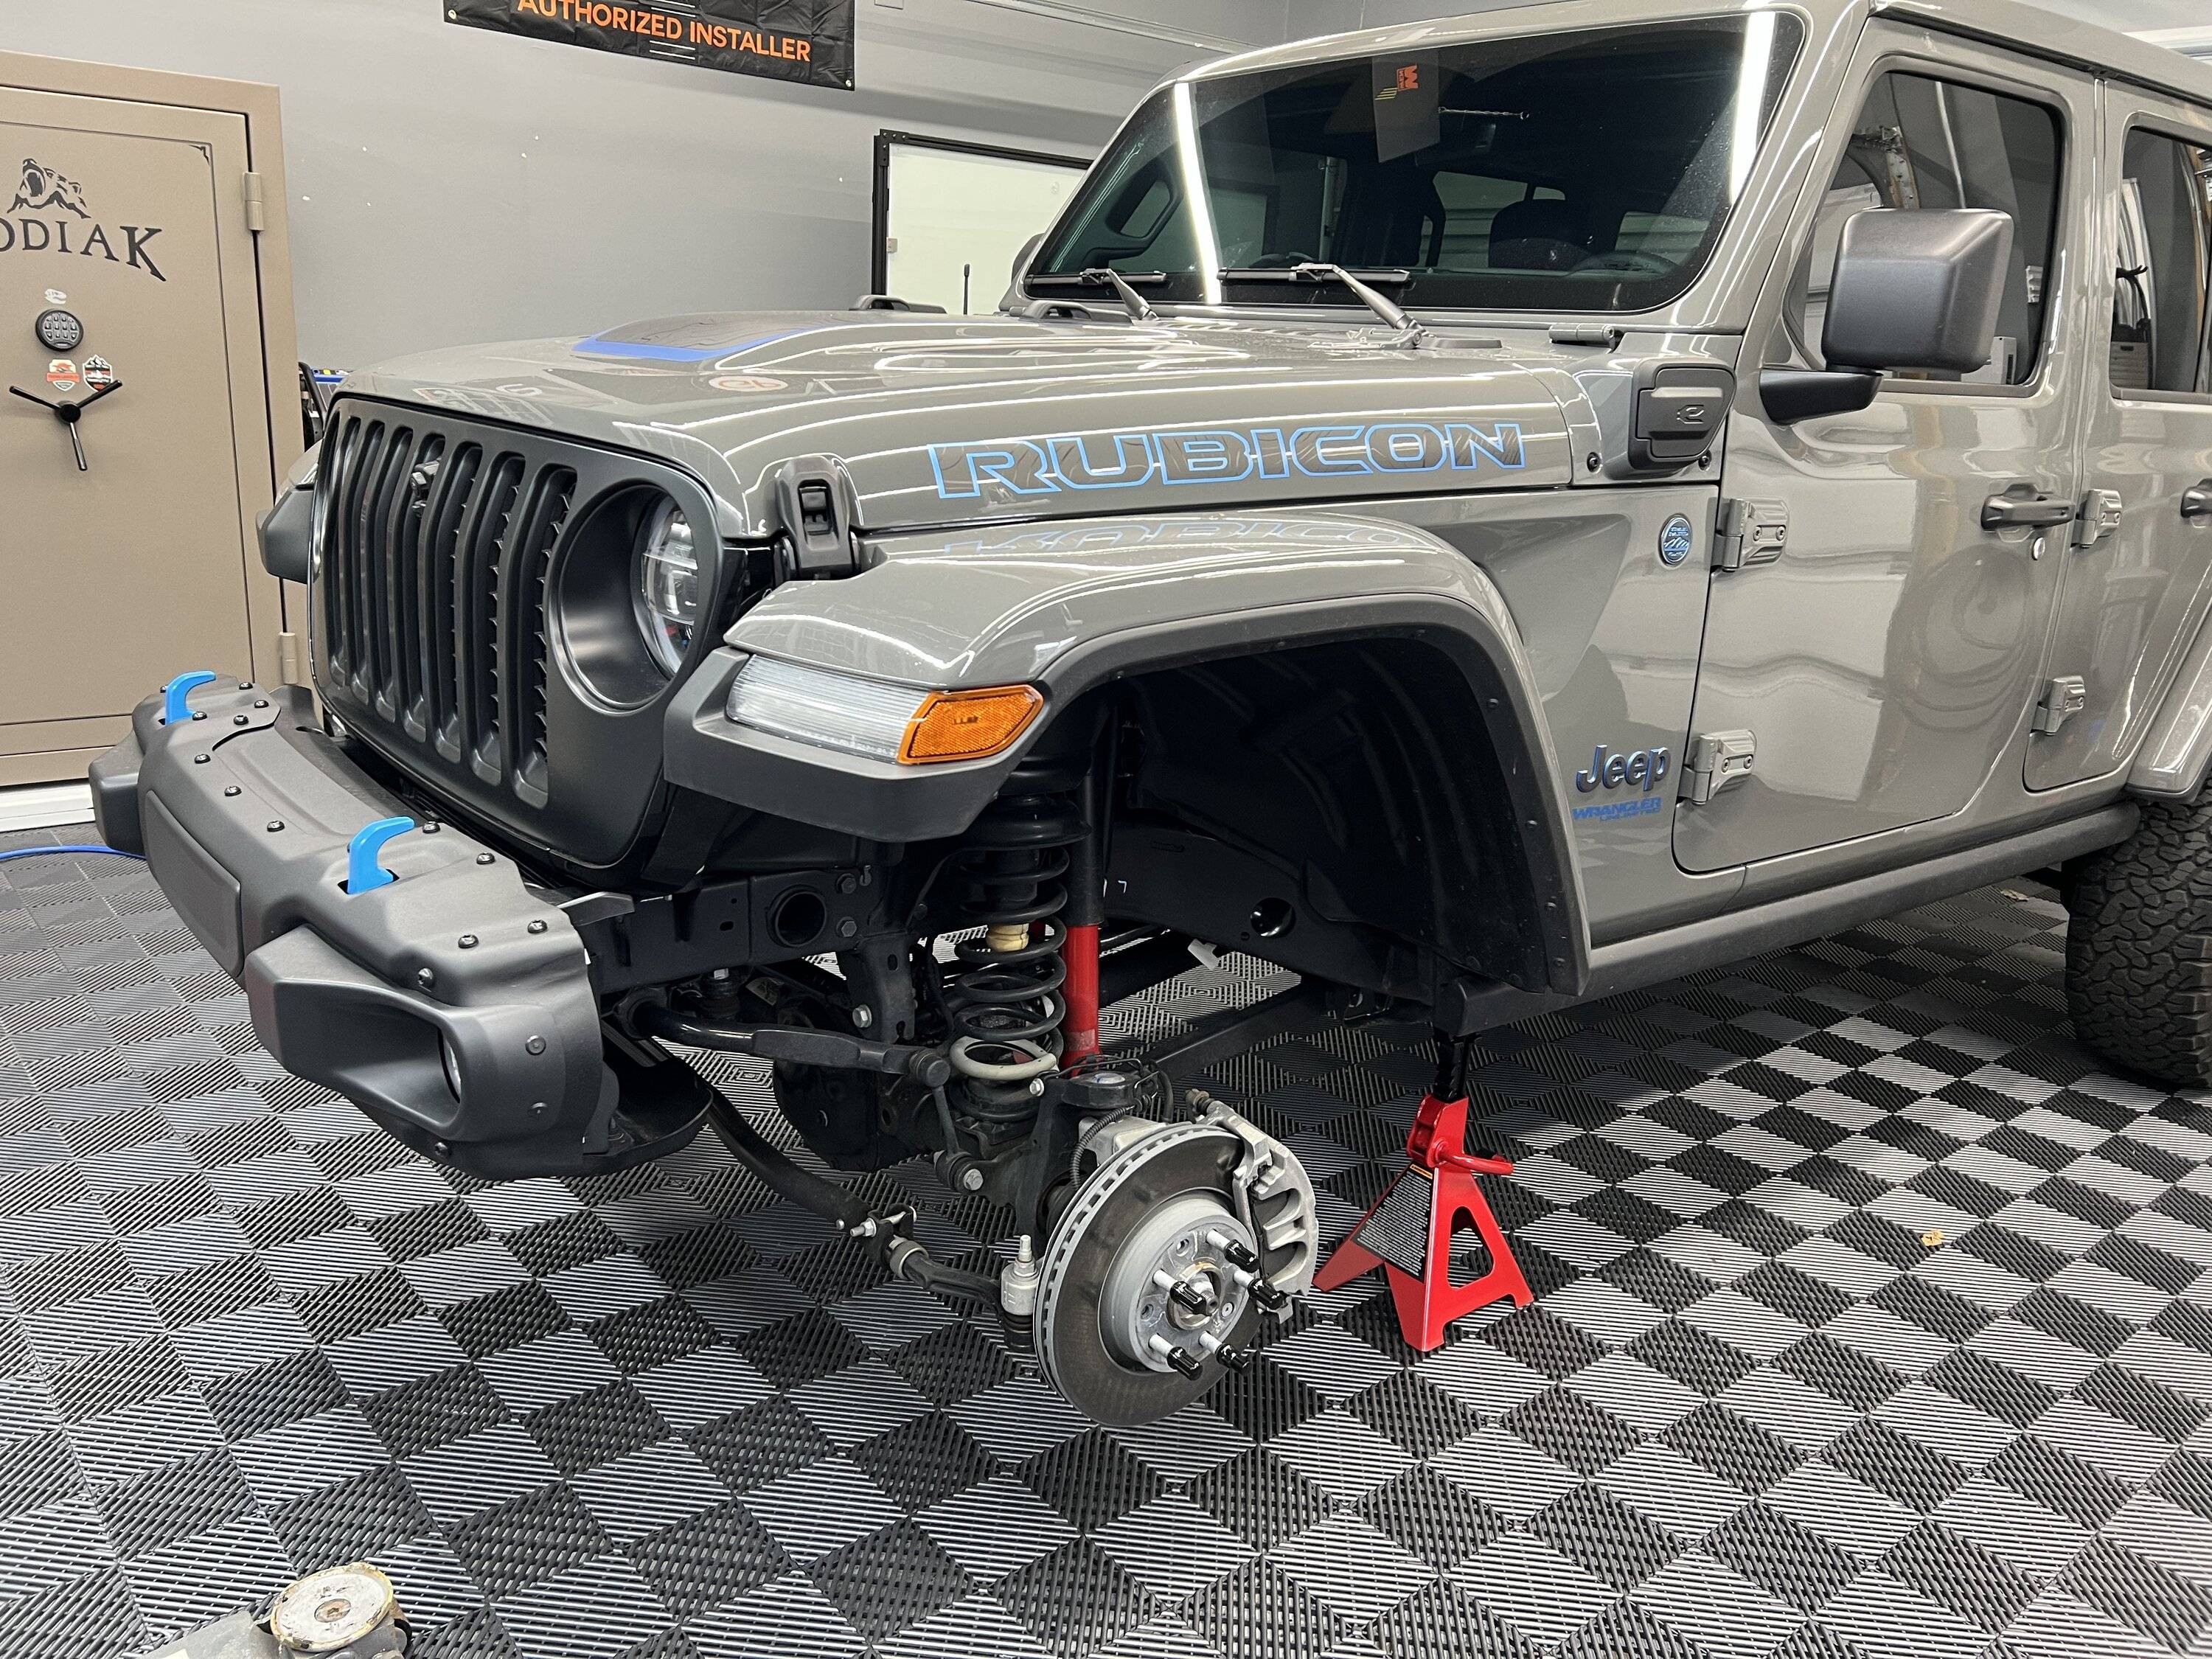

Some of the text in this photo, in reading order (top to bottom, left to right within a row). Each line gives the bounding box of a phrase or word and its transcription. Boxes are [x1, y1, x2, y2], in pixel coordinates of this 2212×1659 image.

[518, 0, 811, 62] AUTHORIZED INSTALLER
[927, 422, 1526, 499] RUBICON
[1576, 744, 1672, 793] Jeep
